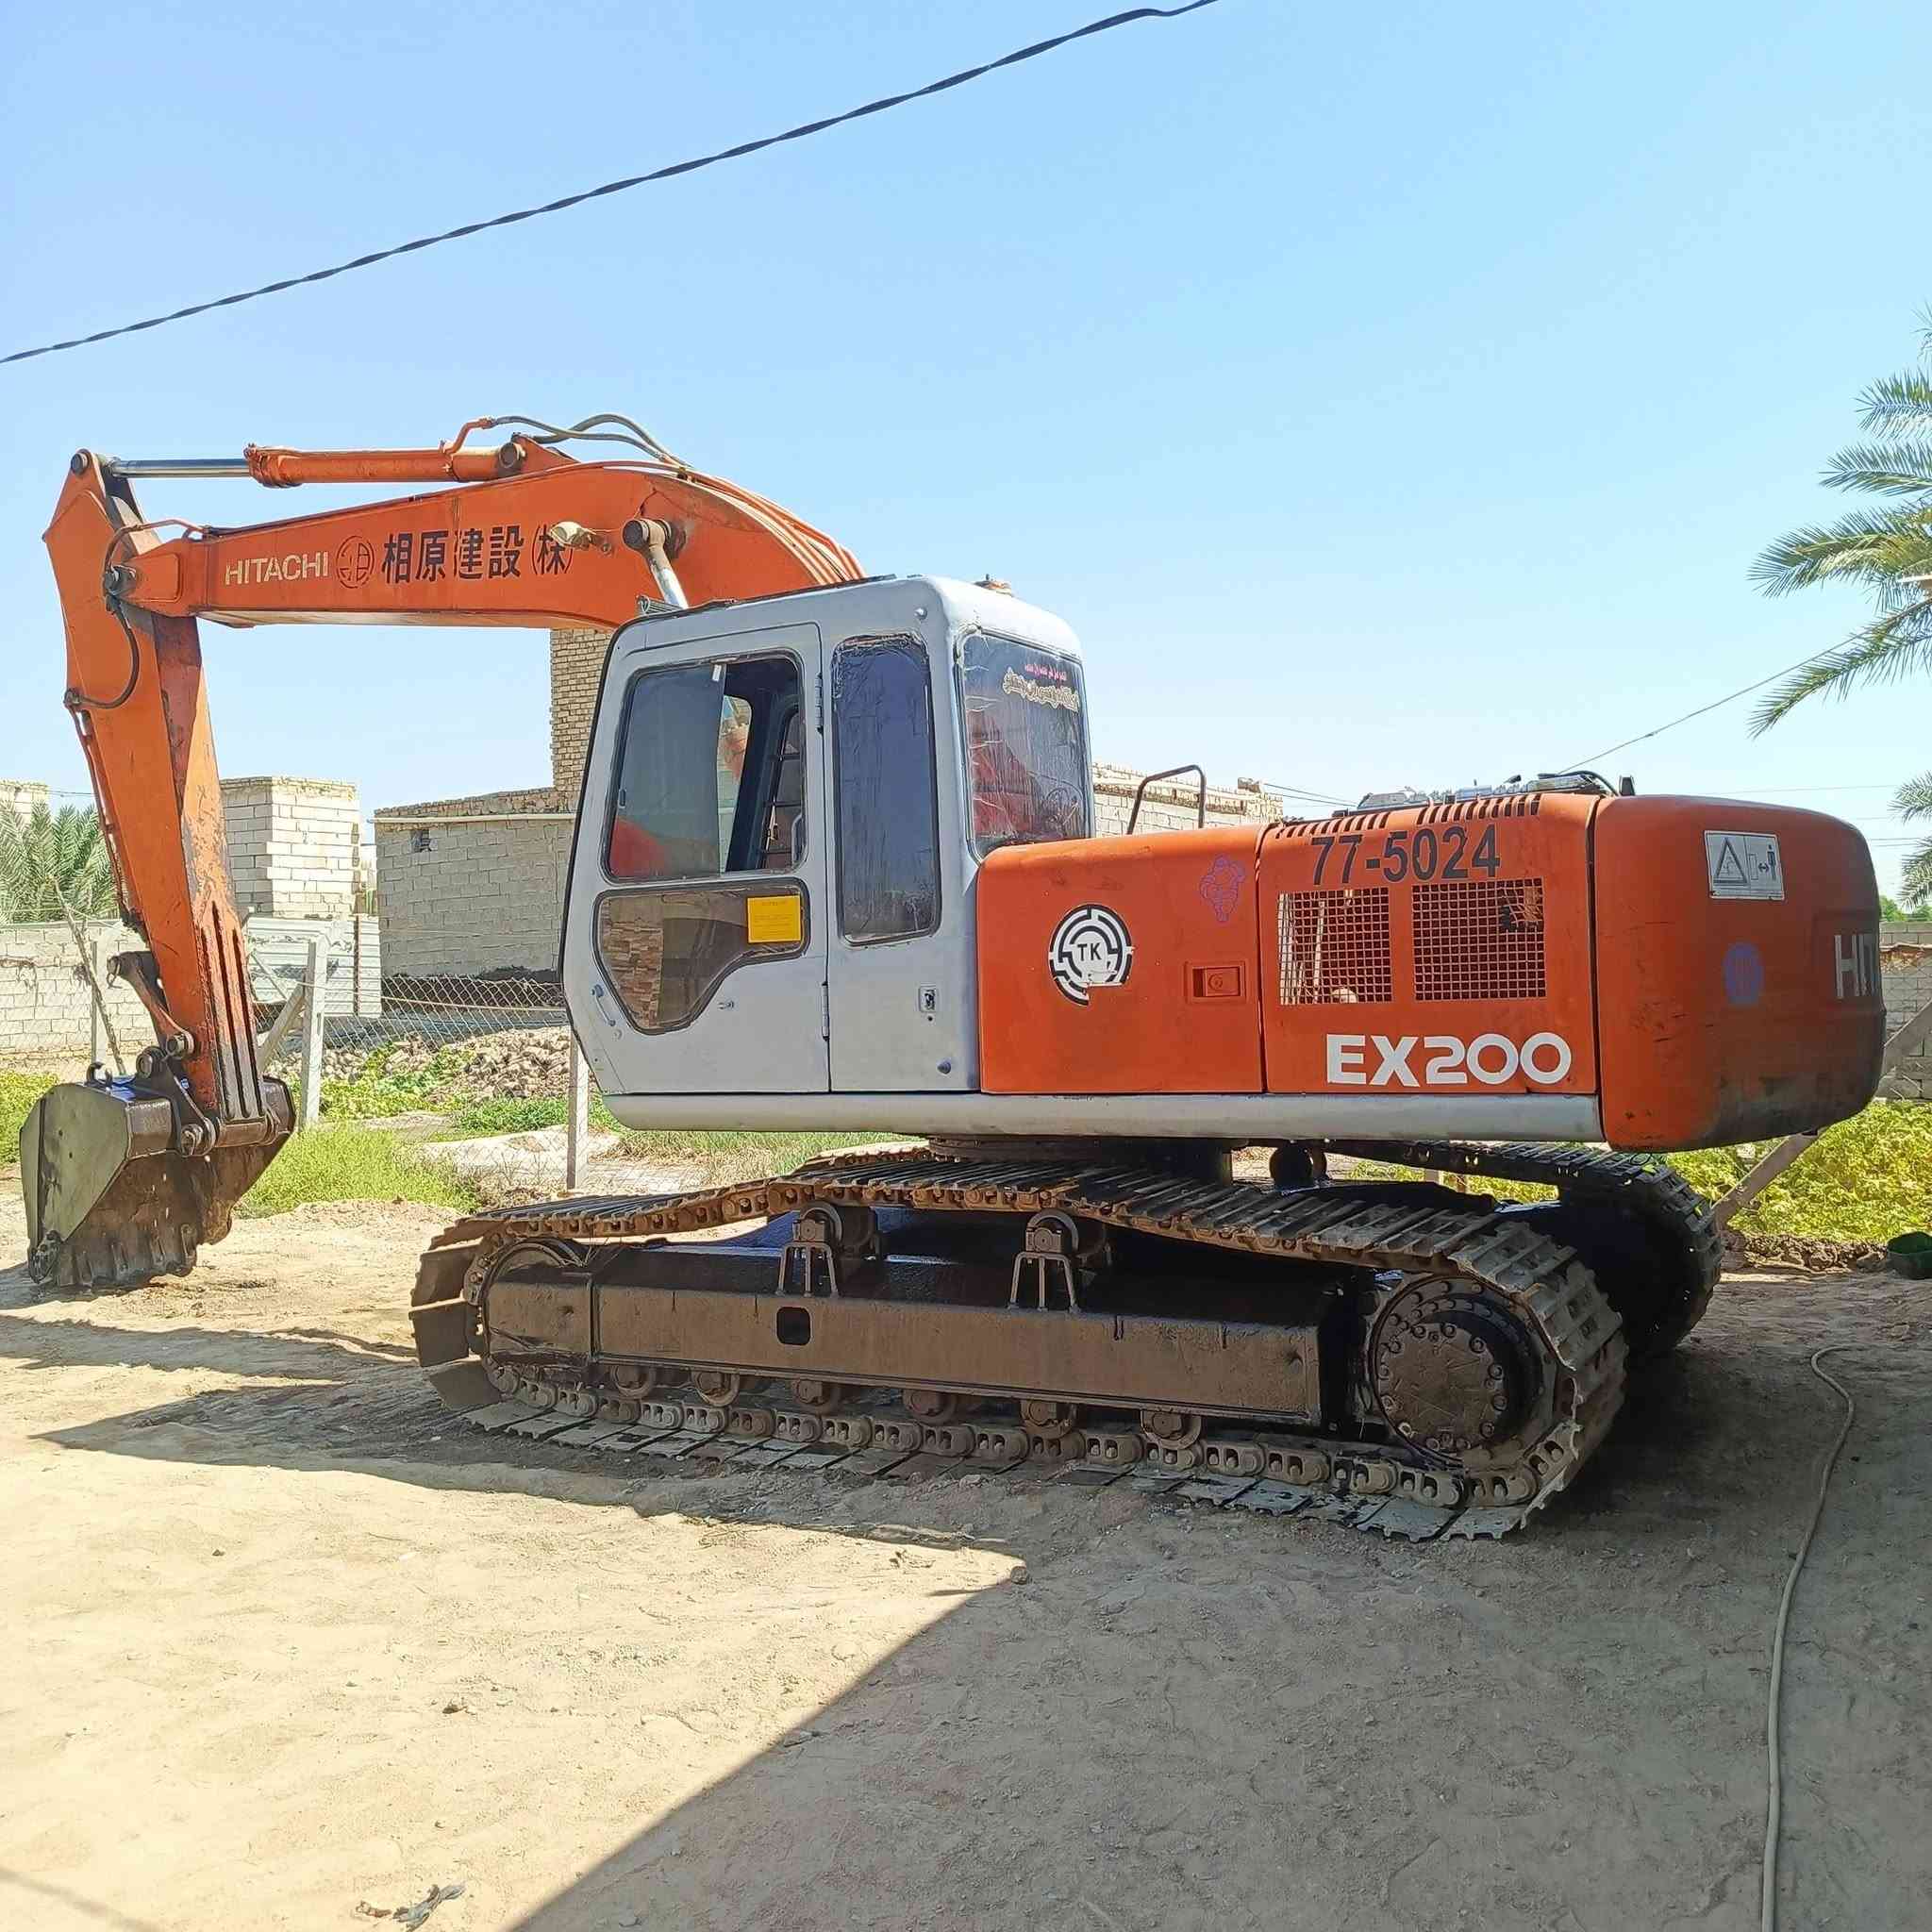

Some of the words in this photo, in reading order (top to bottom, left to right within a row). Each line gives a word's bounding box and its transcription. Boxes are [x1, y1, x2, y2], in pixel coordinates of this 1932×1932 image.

[225, 552, 328, 585] HITACHI
[1310, 824, 1501, 886] 77-5024
[1077, 942, 1102, 961] TK
[1326, 1032, 1572, 1088] EX200
